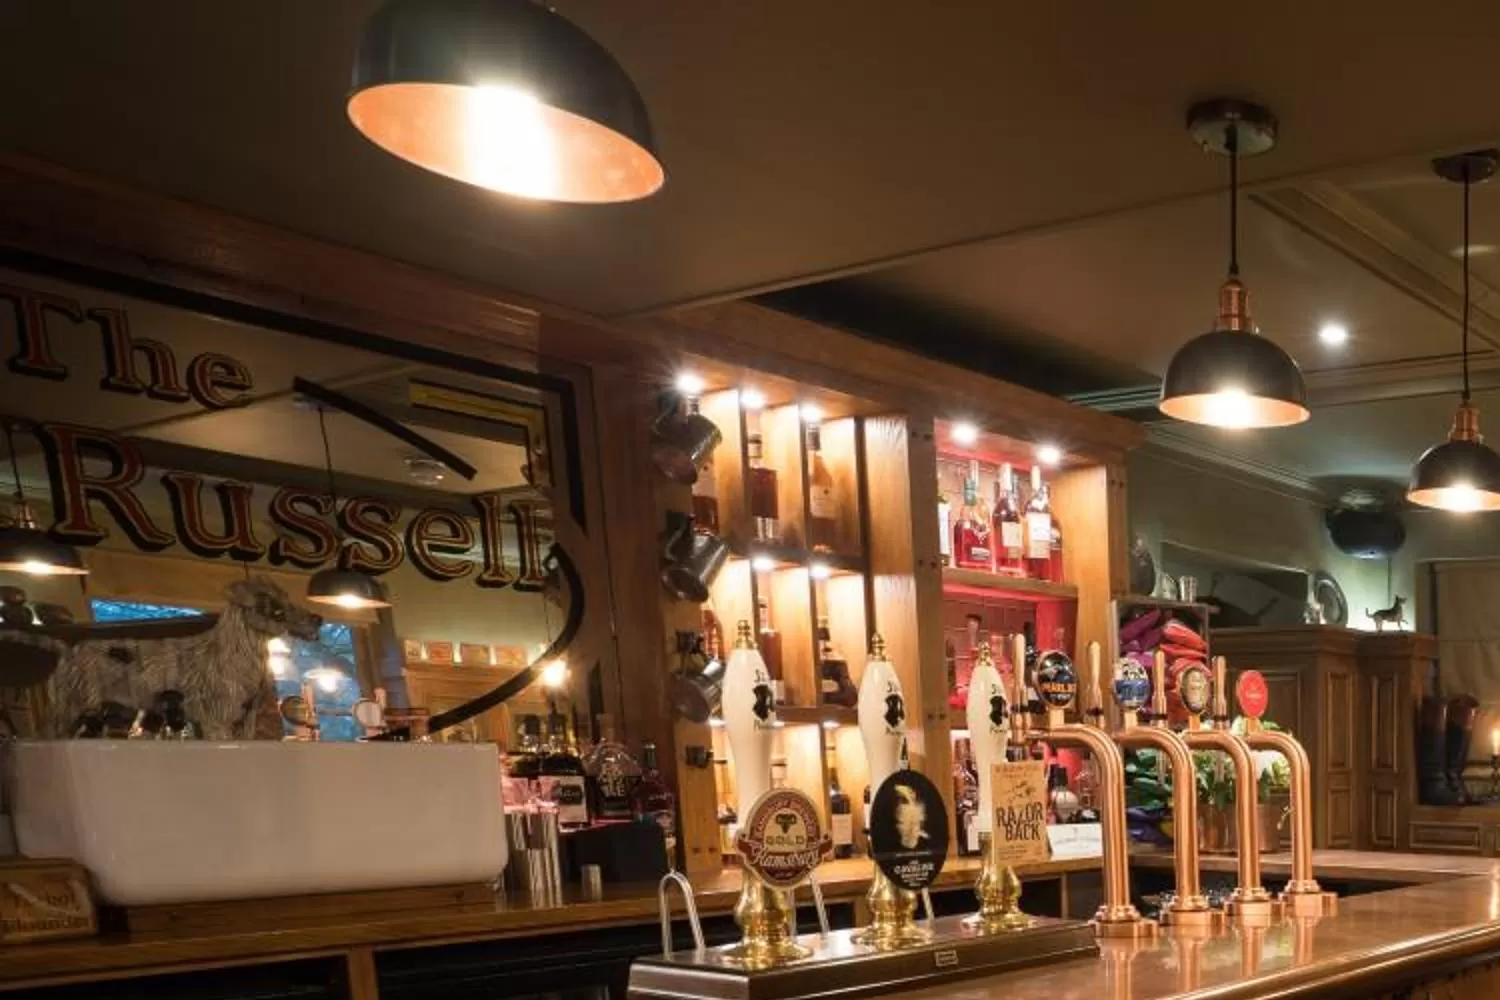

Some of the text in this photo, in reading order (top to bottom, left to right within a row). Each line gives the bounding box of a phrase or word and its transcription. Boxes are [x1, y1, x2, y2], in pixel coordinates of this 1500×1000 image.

[0, 283, 254, 410] The
[35, 420, 550, 594] Russell
[996, 801, 1044, 828] RAZOR
[1005, 822, 1041, 841] BACK
